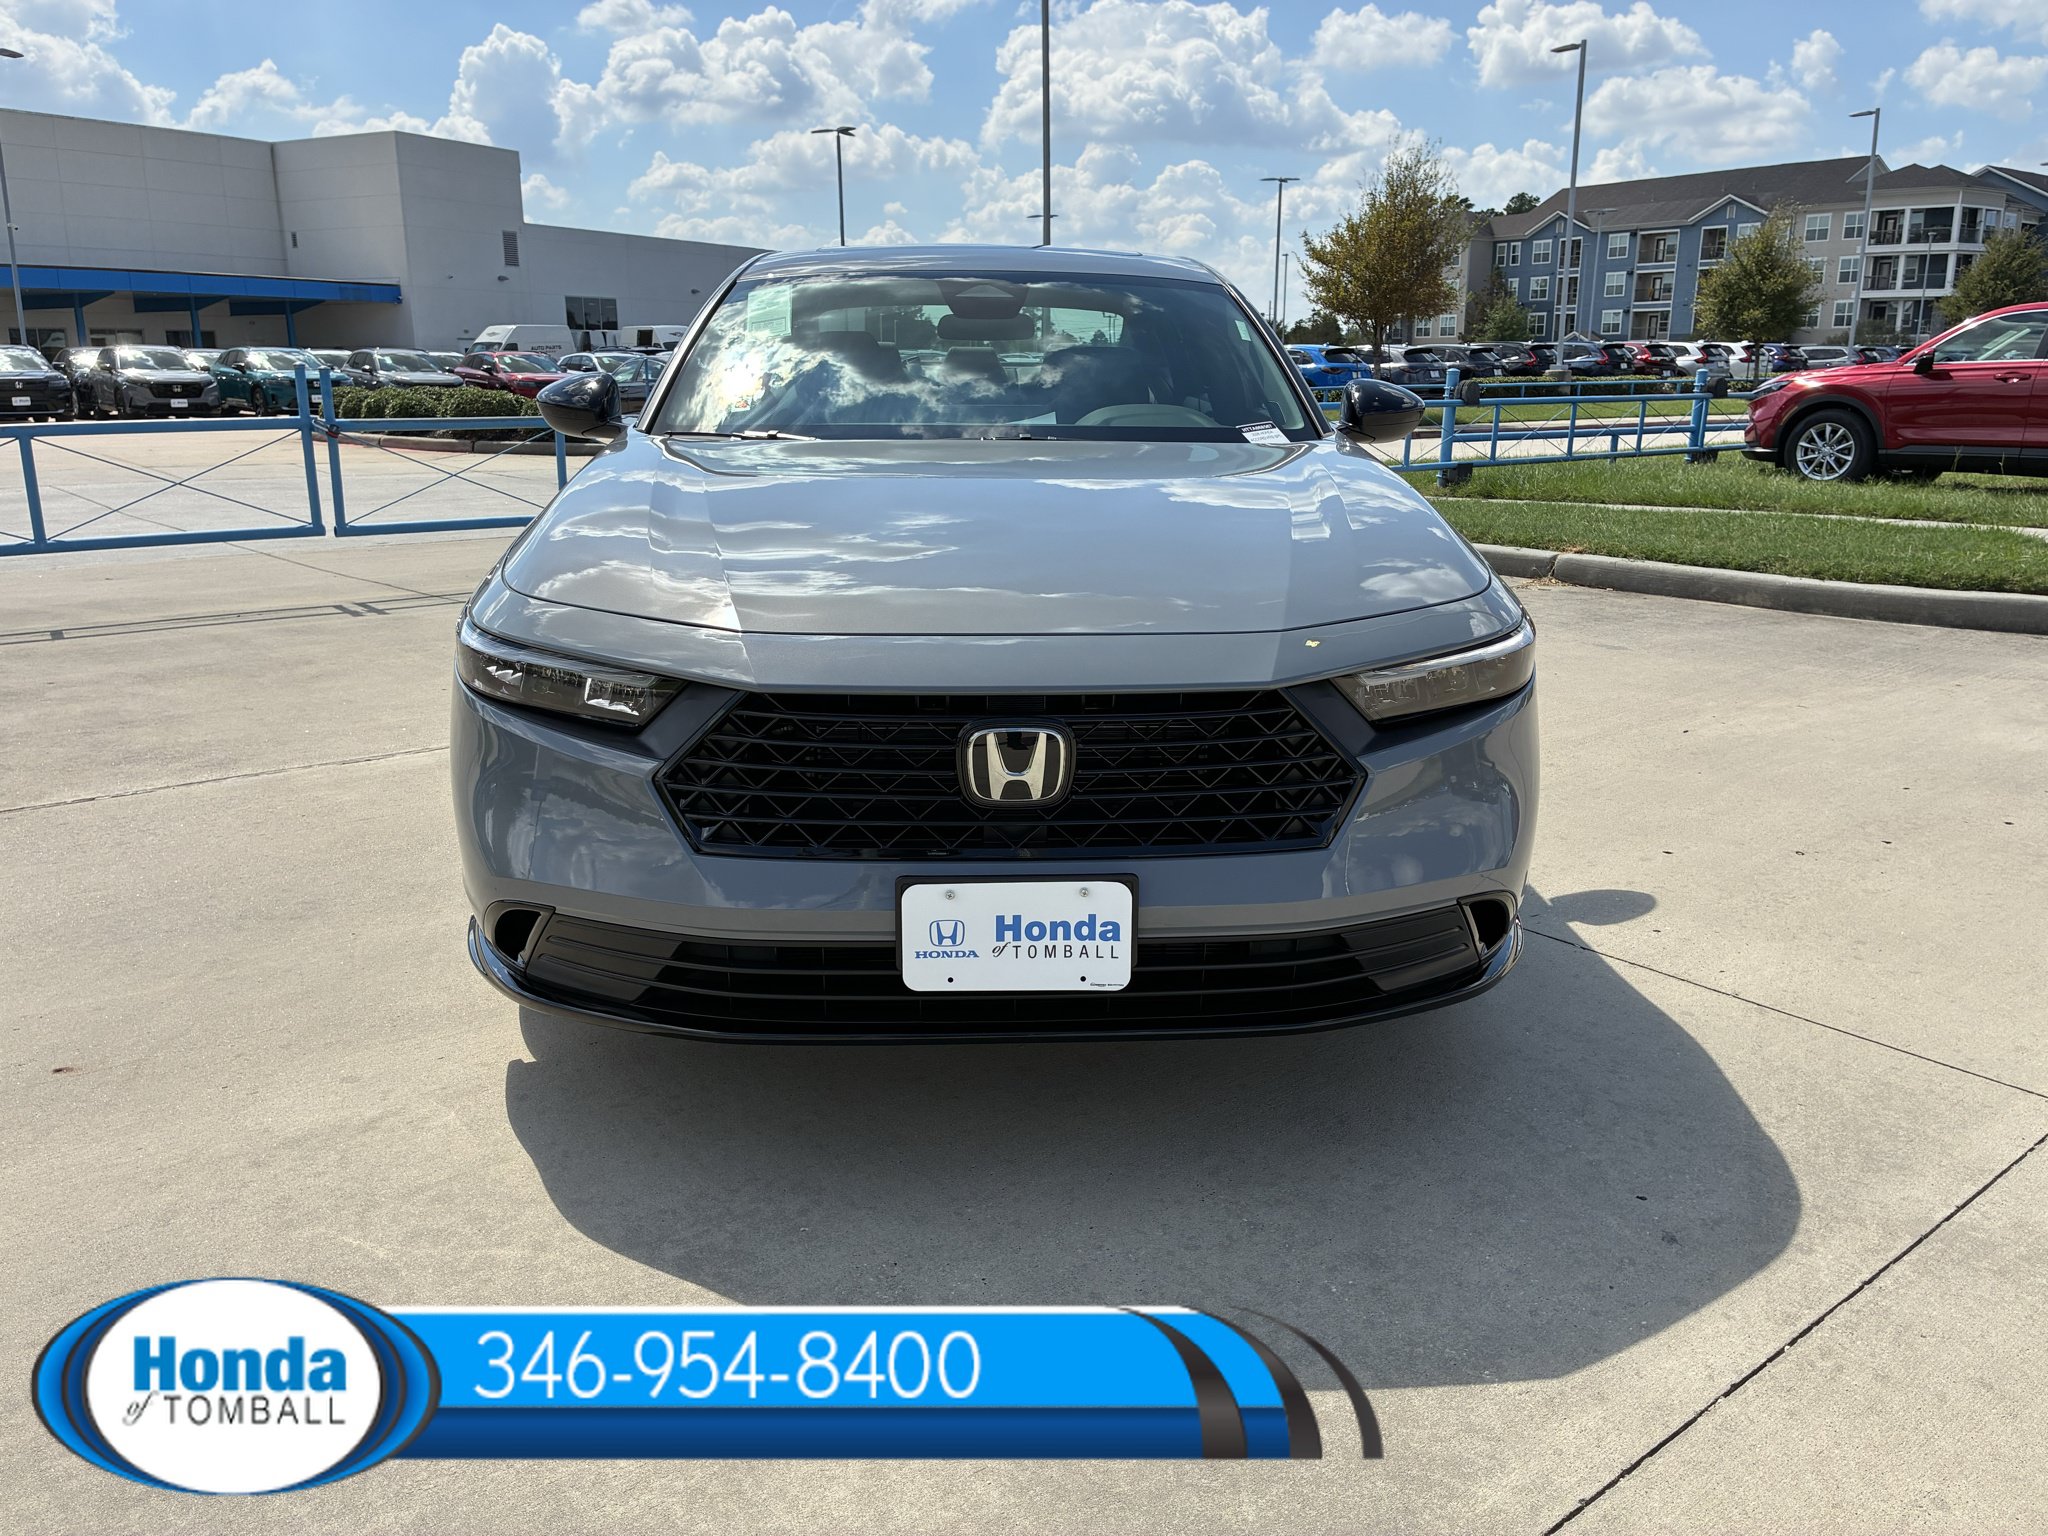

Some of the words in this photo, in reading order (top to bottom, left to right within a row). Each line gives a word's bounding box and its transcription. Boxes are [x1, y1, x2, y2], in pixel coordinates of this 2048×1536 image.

[995, 914, 1121, 942] Honda
[915, 949, 980, 959] HONDA
[992, 941, 1012, 957] of
[1012, 944, 1119, 959] TOMBALL
